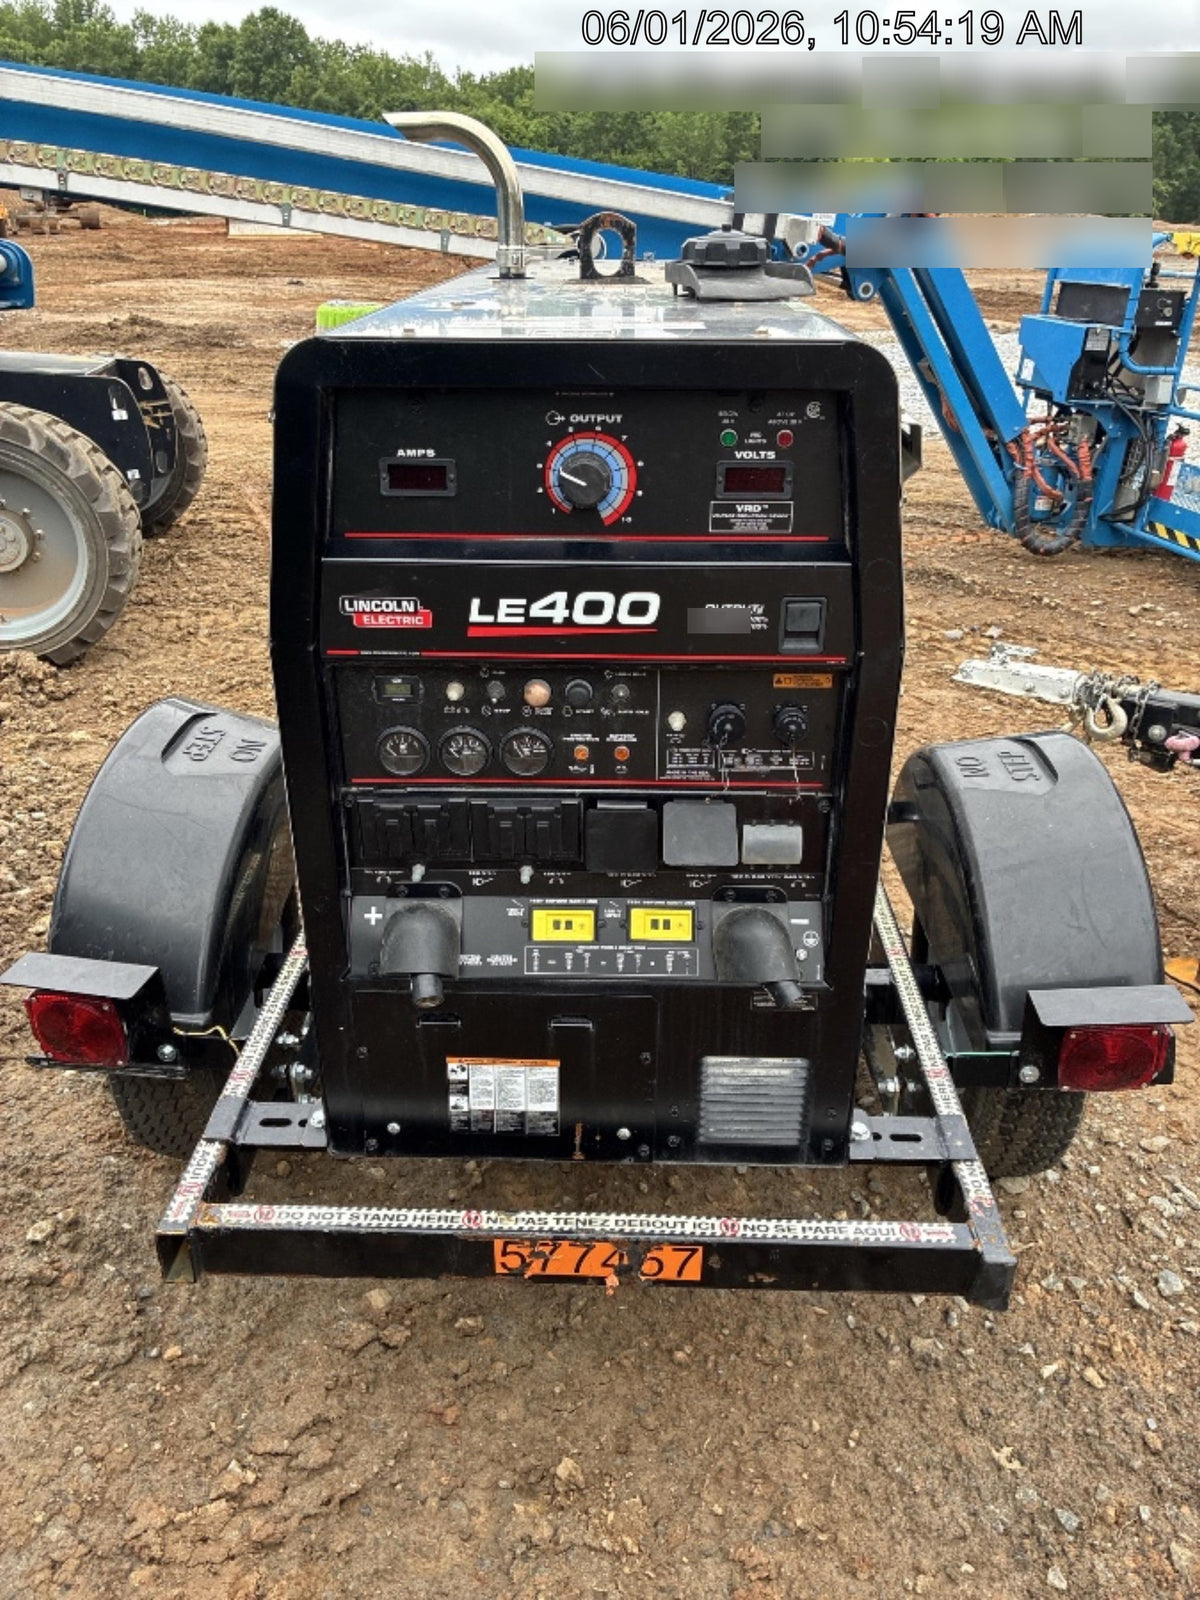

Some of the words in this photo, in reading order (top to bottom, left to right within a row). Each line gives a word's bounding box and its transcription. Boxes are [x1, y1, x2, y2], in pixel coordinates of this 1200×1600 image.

[569, 413, 623, 423] OUTPUT
[396, 448, 436, 457] AMPS
[734, 450, 776, 459] VOLTS
[344, 599, 415, 613] LINCOLN
[468, 590, 661, 626] LE400
[362, 614, 424, 626] ELECTRIC
[230, 738, 268, 762] NO
[954, 755, 991, 778] NO
[996, 750, 1042, 782] STEP
[187, 1149, 215, 1180] AQUI
[276, 1211, 305, 1221] DO
[306, 1211, 347, 1222] NOT
[348, 1212, 409, 1223] STAND
[412, 1213, 461, 1224] HERE
[514, 1217, 549, 1226] PAS
[552, 1217, 611, 1228] TENEZ
[614, 1219, 689, 1229] DEBOUT
[692, 1221, 716, 1231] ICI
[742, 1223, 770, 1233] NO
[774, 1224, 797, 1234] SE
[801, 1225, 849, 1235] PARE
[852, 1226, 897, 1237] AQUI
